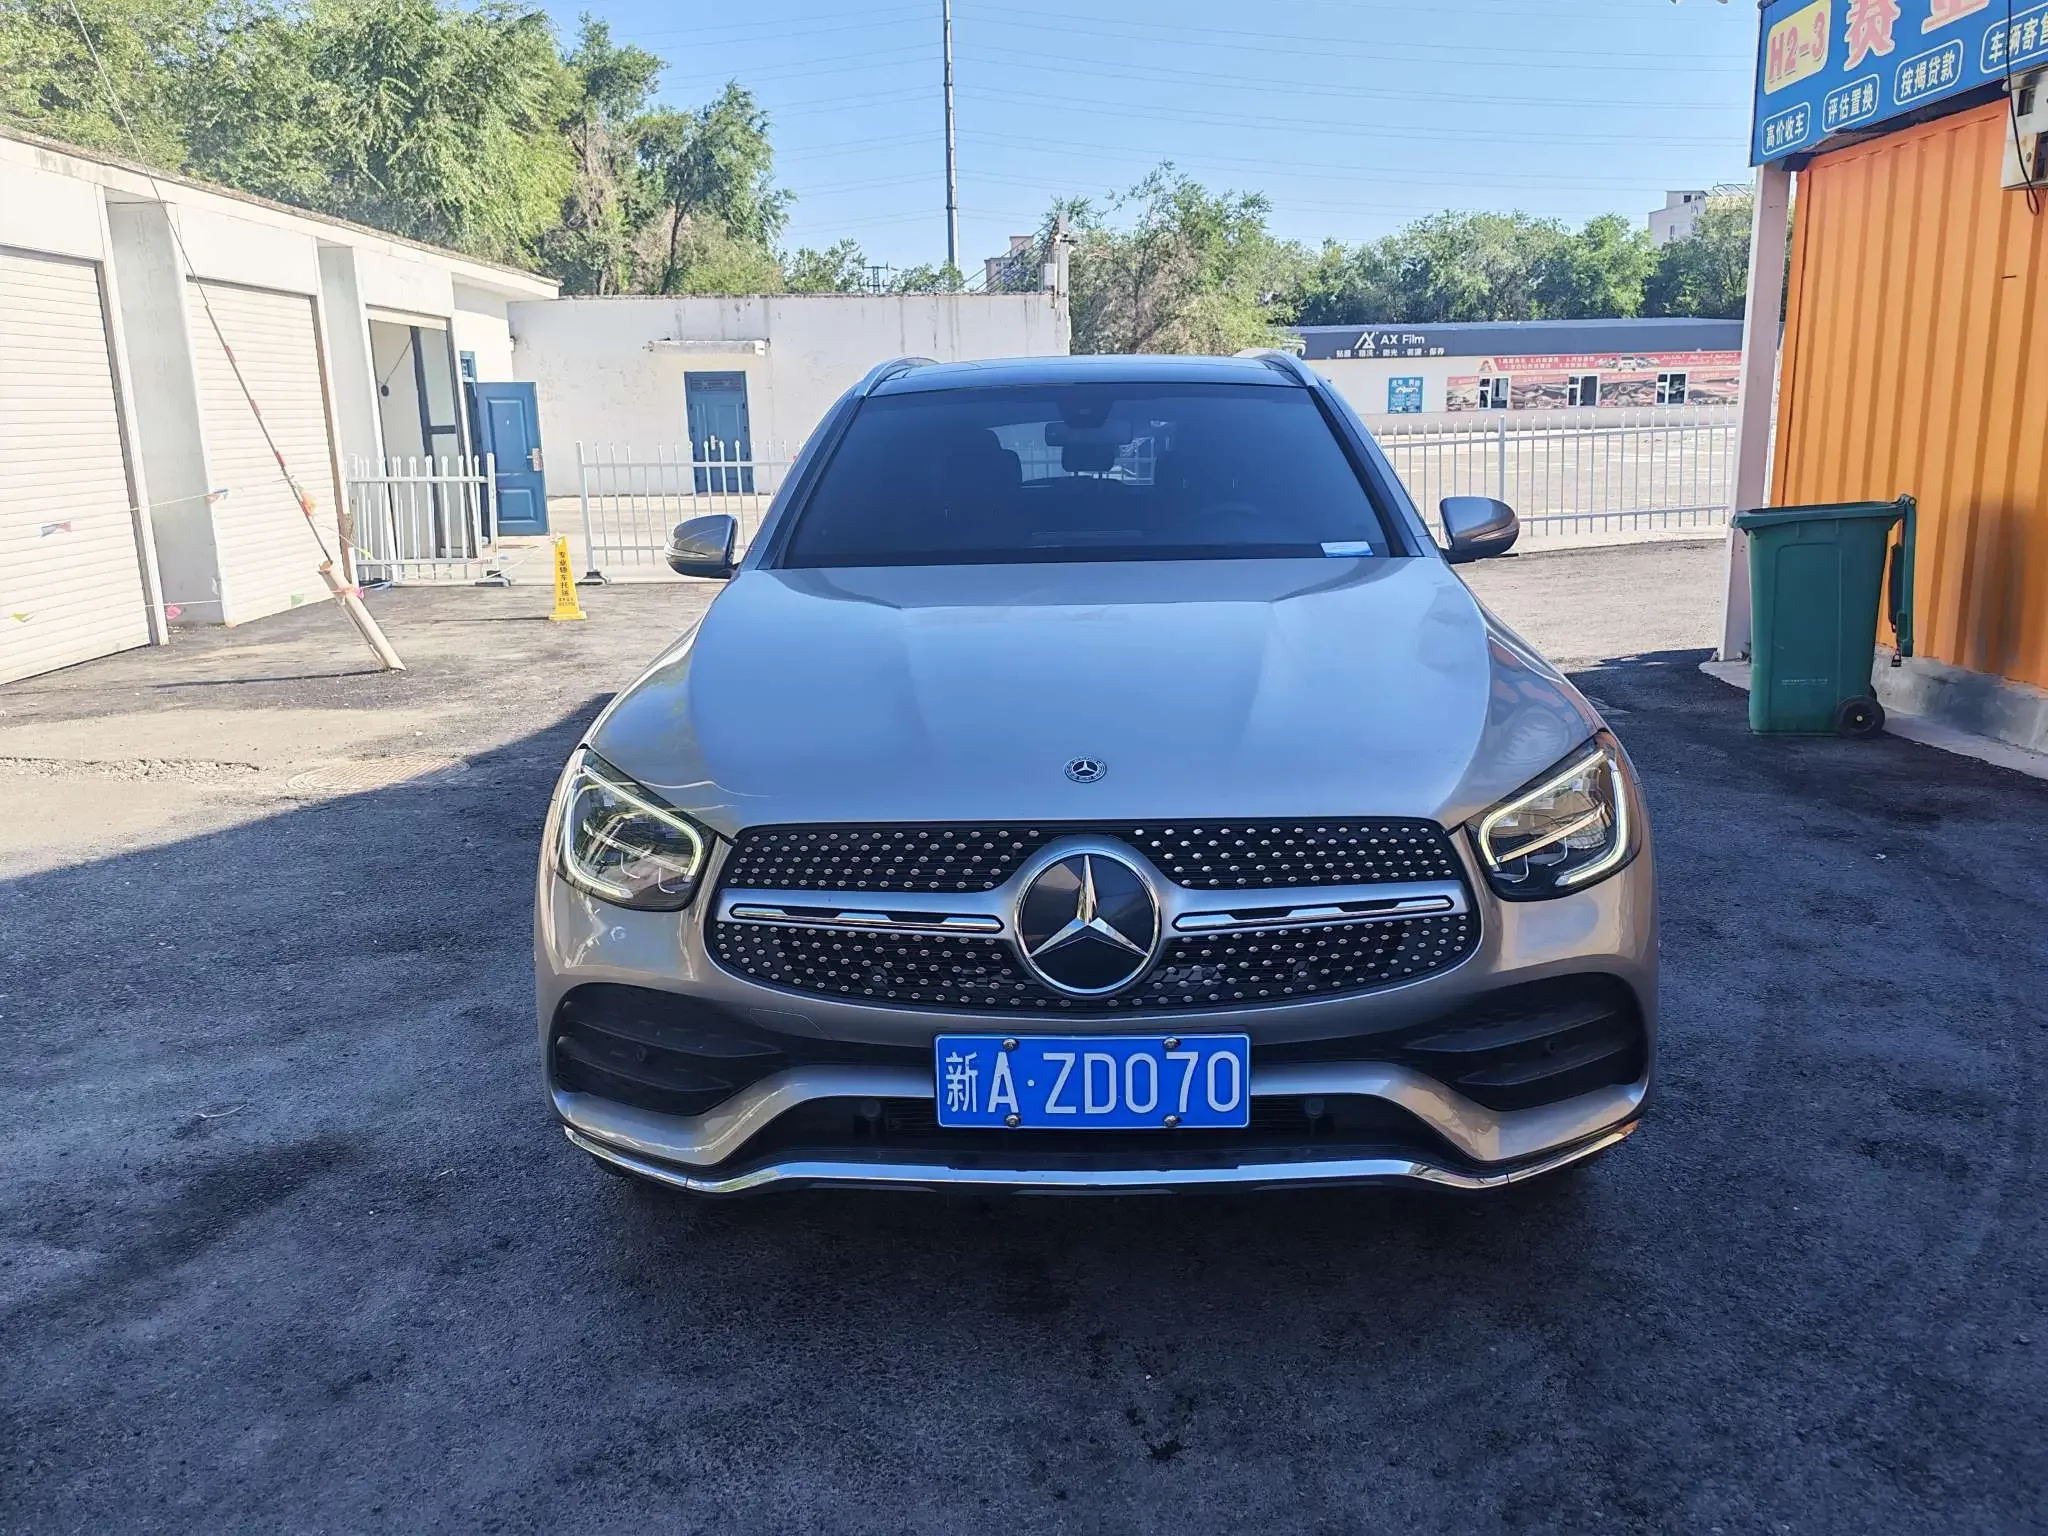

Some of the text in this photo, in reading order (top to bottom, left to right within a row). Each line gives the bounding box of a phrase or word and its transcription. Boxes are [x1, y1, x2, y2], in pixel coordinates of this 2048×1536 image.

[1768, 11, 1825, 84] H2-3
[1901, 50, 1956, 98] 按揭贷款
[1828, 84, 1873, 124] 评估置换
[1766, 111, 1805, 149] 高价收车
[1380, 334, 1425, 345] AX Film
